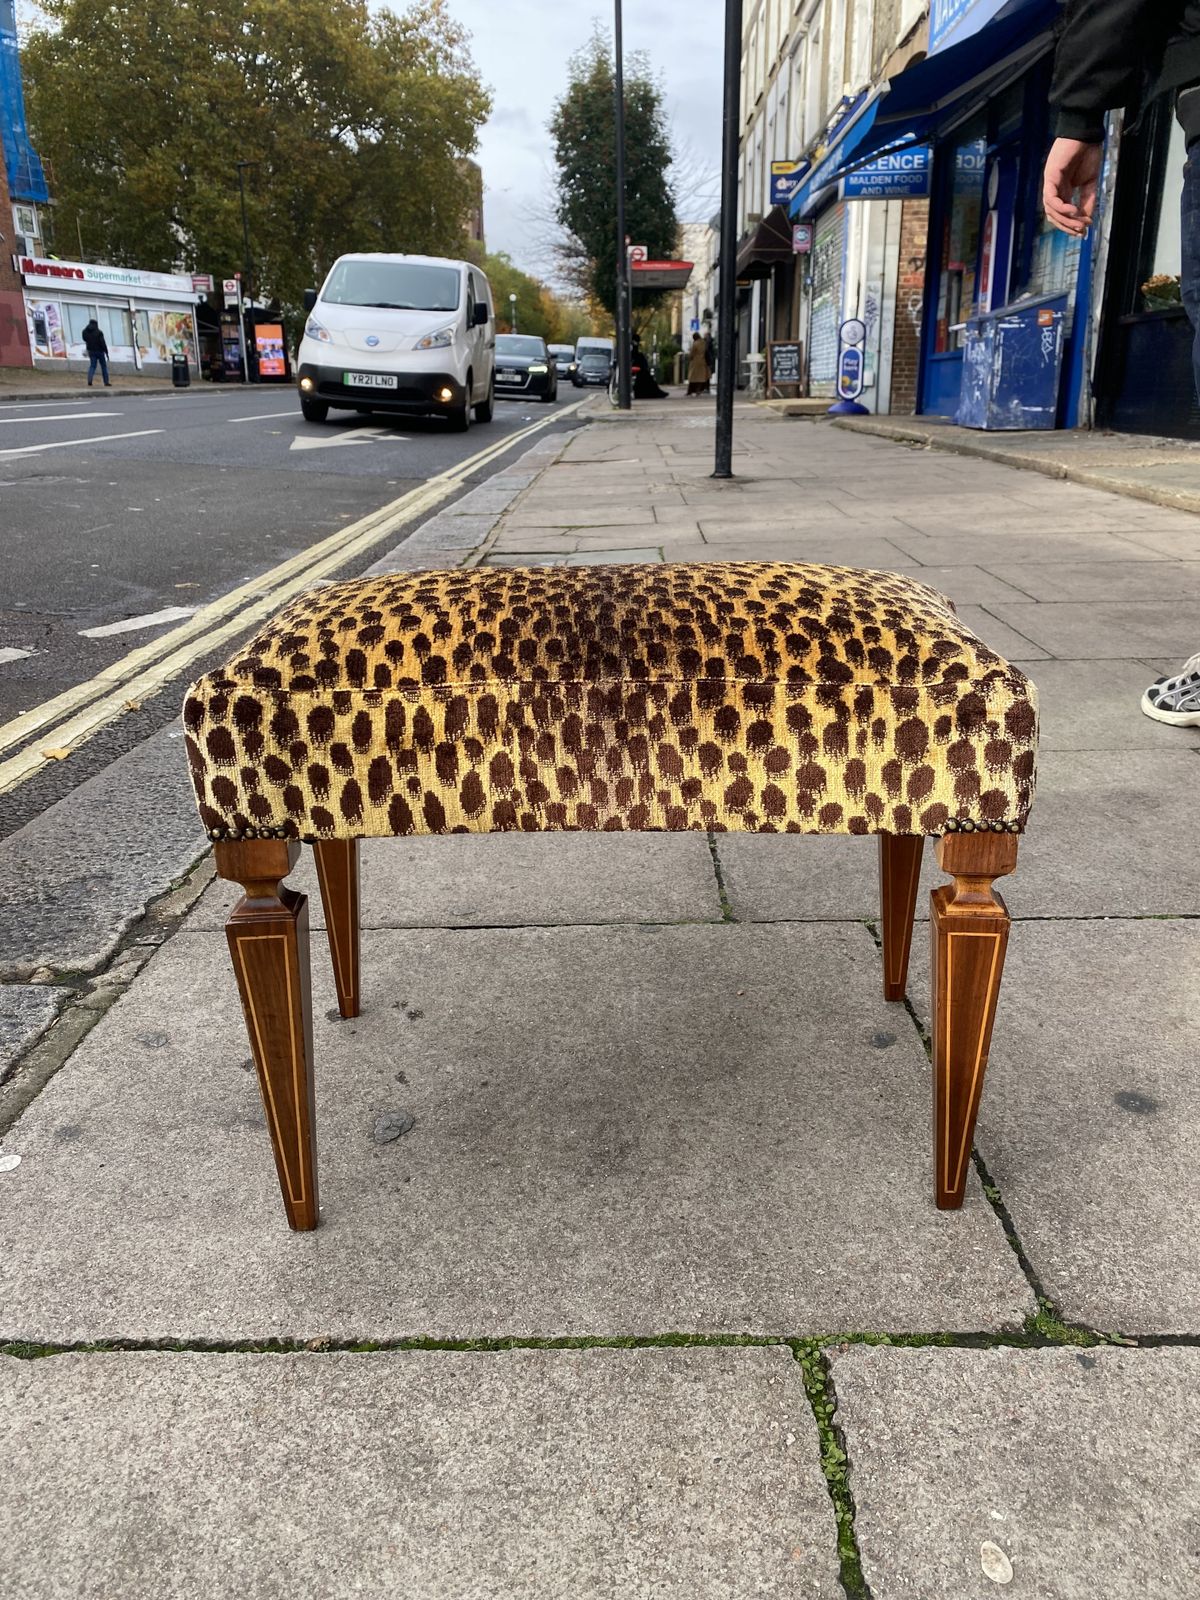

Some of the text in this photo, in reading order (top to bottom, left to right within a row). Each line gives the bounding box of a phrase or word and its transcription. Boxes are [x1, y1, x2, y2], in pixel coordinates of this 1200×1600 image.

[850, 174, 923, 185] MALDEN FOOD
[860, 185, 910, 194] AND WINE
[22, 258, 141, 284] Marmara Supermarket
[352, 374, 373, 385] YR21
